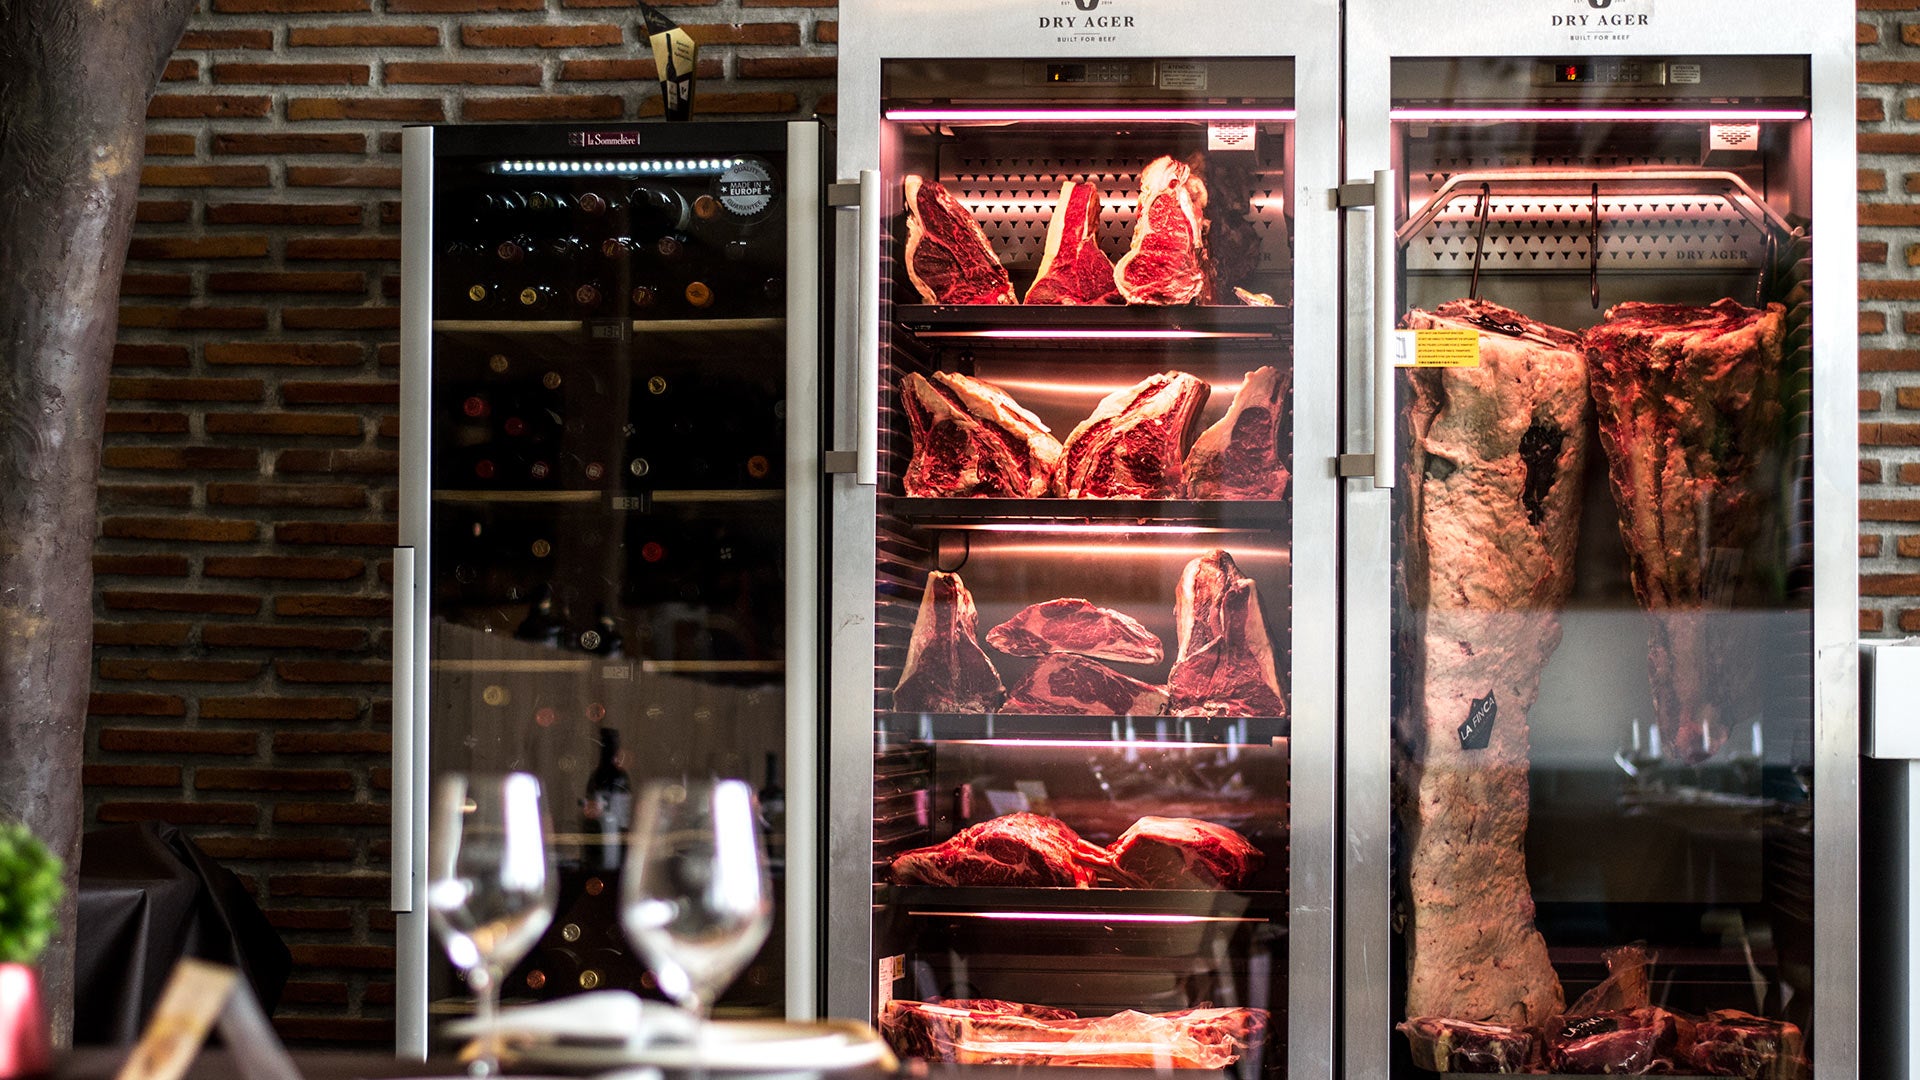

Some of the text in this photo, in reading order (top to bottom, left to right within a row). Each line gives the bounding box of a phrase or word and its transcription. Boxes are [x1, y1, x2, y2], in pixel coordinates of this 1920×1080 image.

[1039, 16, 1135, 28] DRY AGER
[1552, 14, 1649, 26] DRY AGER
[733, 165, 759, 174] QUALITY
[730, 188, 762, 196] EUROPE
[1677, 250, 1748, 259] DRY AGER
[1461, 697, 1494, 740] LA FINCA
